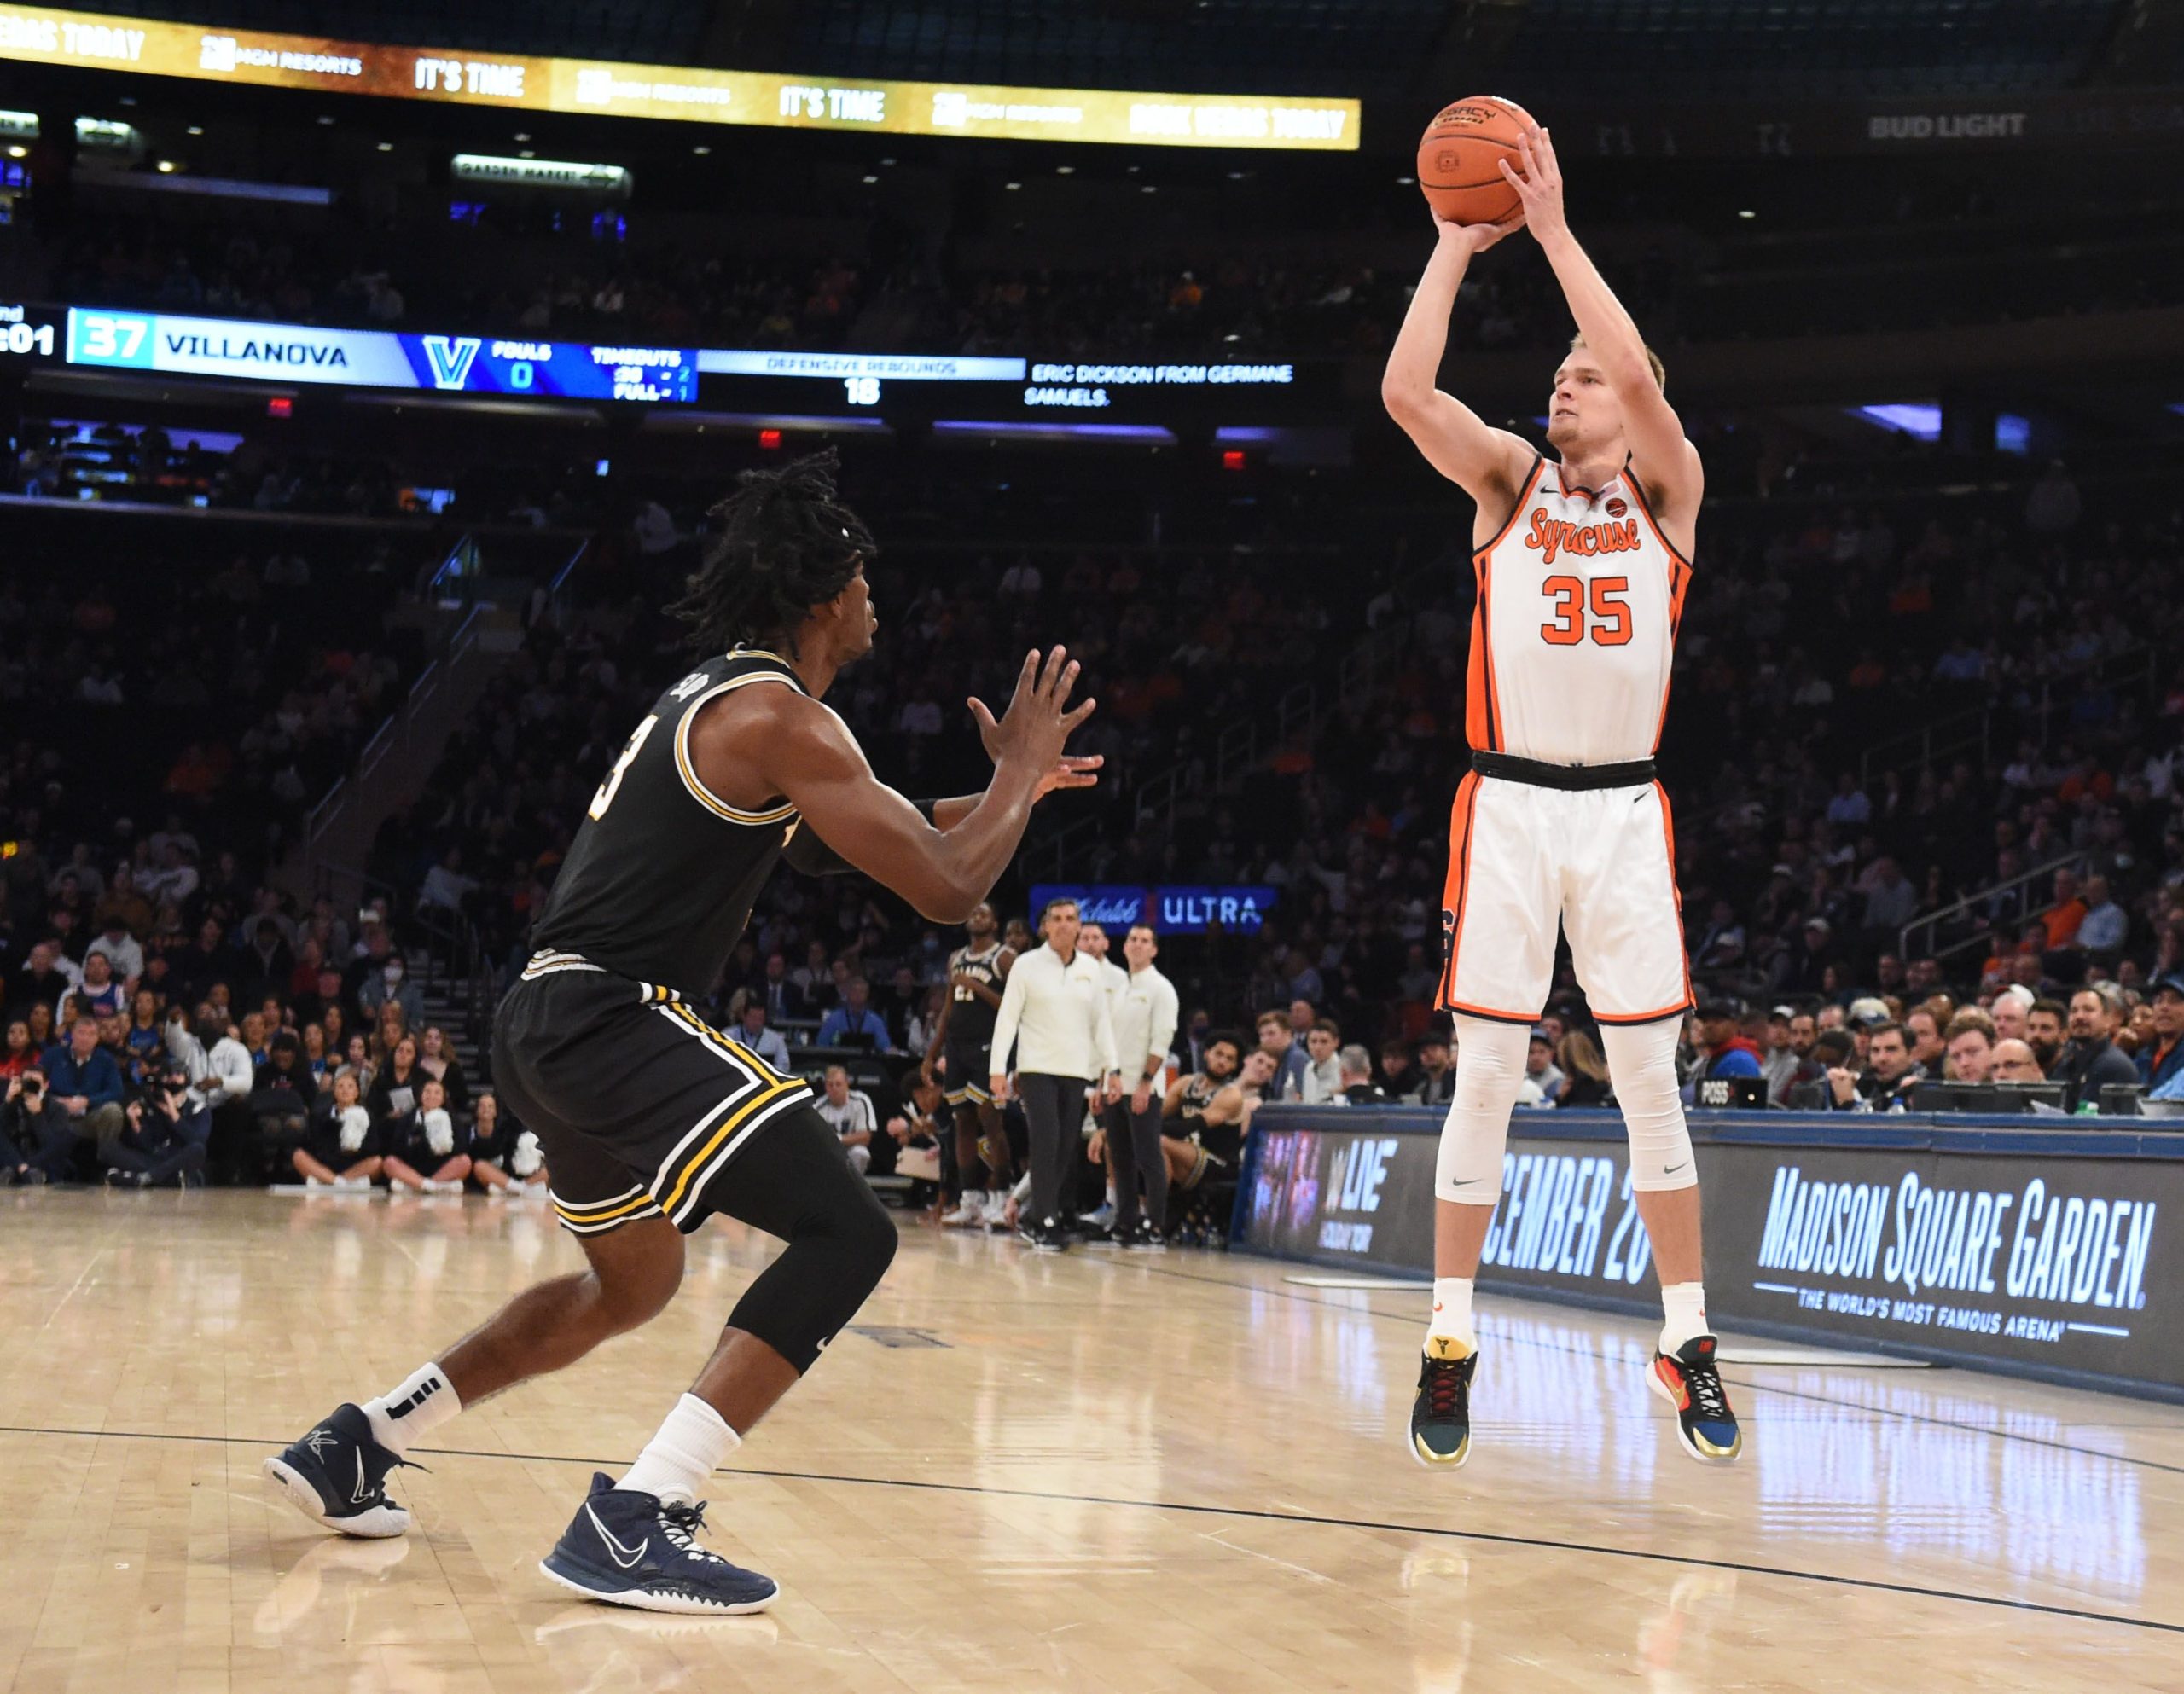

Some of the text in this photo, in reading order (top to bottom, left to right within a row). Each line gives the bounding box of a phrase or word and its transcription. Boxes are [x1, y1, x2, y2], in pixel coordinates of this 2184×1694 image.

[280, 51, 362, 75] RESORTS
[415, 57, 525, 97] IT'S TIME
[779, 85, 886, 122] IT'S TIME
[1869, 113, 2026, 139] BUD LIGHT
[0, 304, 24, 322] nd
[83, 316, 148, 359] 37
[166, 334, 349, 368] VILLANOVA
[491, 341, 552, 361] FOULS
[590, 346, 682, 368] TIMEOUTS
[767, 358, 957, 374] DEFENSIVE REBOUNDS
[510, 361, 533, 389] 0
[1031, 364, 1293, 383] ERIC DICKSON FROM GERMANE
[844, 377, 880, 404] 18
[1525, 508, 1641, 564] Syracuse
[1541, 575, 1633, 646] 35
[588, 713, 659, 821] 3
[1163, 896, 1263, 924] ULTRA
[1701, 1080, 1729, 1105] POSS
[1481, 1152, 1614, 1277] CEMBER
[1757, 1166, 2156, 1310] MADISON SQUARE GARDEN
[1798, 1288, 1825, 1311] THE
[1827, 1292, 1890, 1320] WORLD'S
[1892, 1301, 1935, 1326] MOST
[1937, 1307, 2001, 1336] FAMOUS
